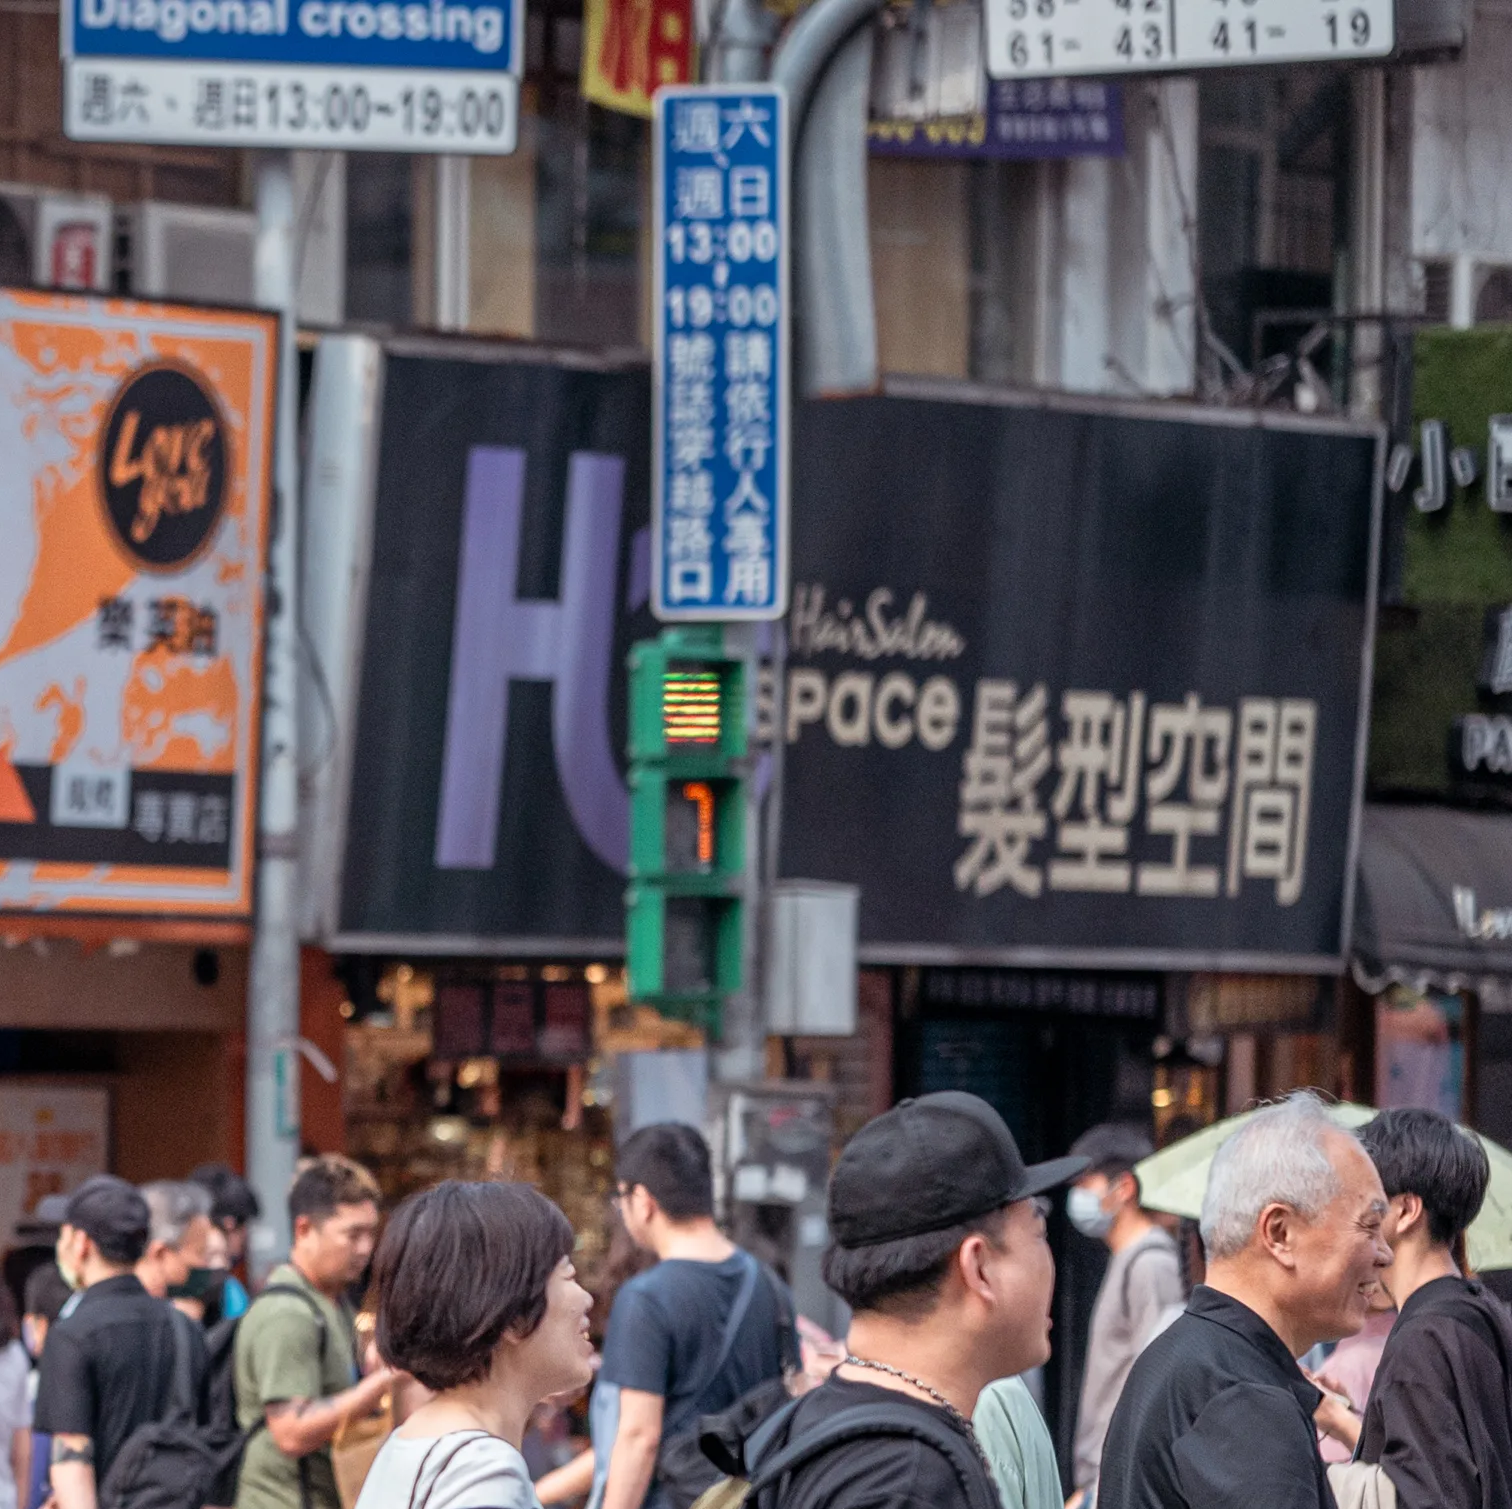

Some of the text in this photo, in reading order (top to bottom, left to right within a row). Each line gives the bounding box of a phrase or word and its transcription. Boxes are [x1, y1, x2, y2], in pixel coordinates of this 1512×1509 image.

[80, 0, 506, 54] Diagonal crossing
[952, 676, 1319, 908] 髮型空間
